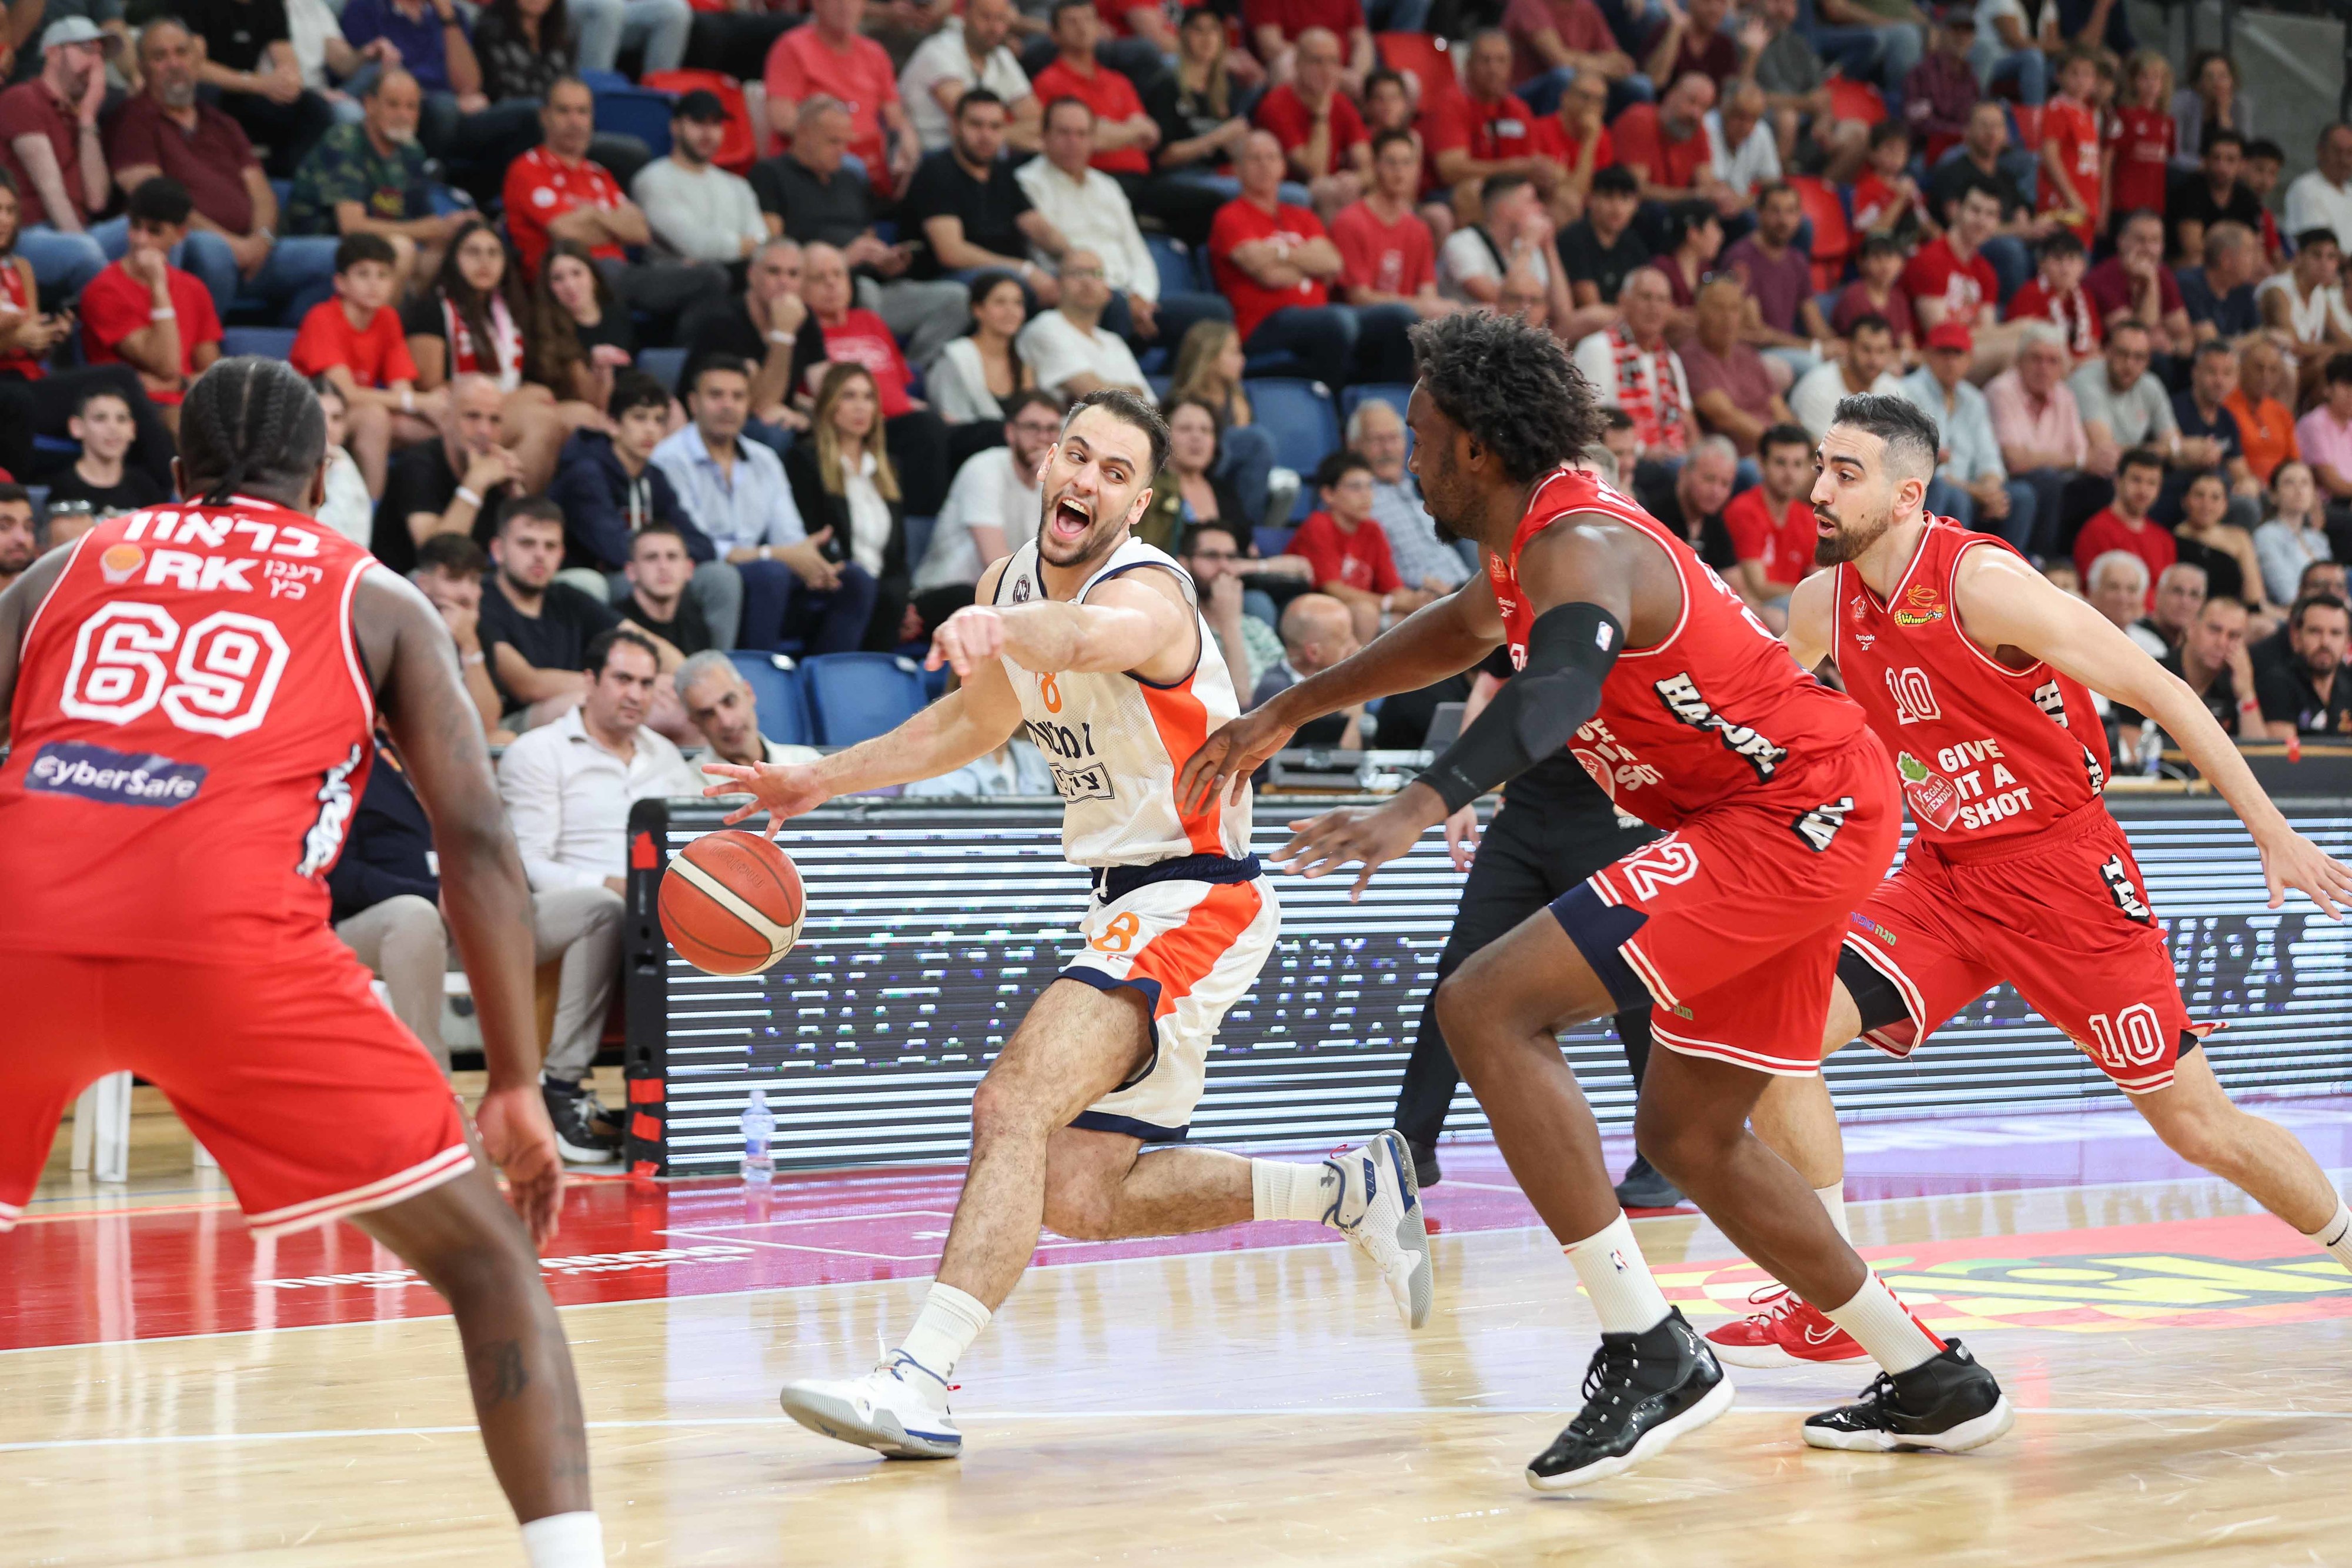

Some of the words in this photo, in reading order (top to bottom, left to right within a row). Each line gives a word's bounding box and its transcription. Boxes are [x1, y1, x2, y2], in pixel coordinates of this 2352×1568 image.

[123, 511, 320, 557] בראון
[59, 601, 291, 740] 69
[1885, 666, 1941, 726] 10
[1937, 738, 2005, 773] GIVE
[1914, 778, 1945, 806] VEGAN
[1953, 770, 1984, 801] IT
[1992, 763, 2017, 788] A
[1959, 787, 2033, 830] SHOT
[2088, 1002, 2166, 1068] 10
